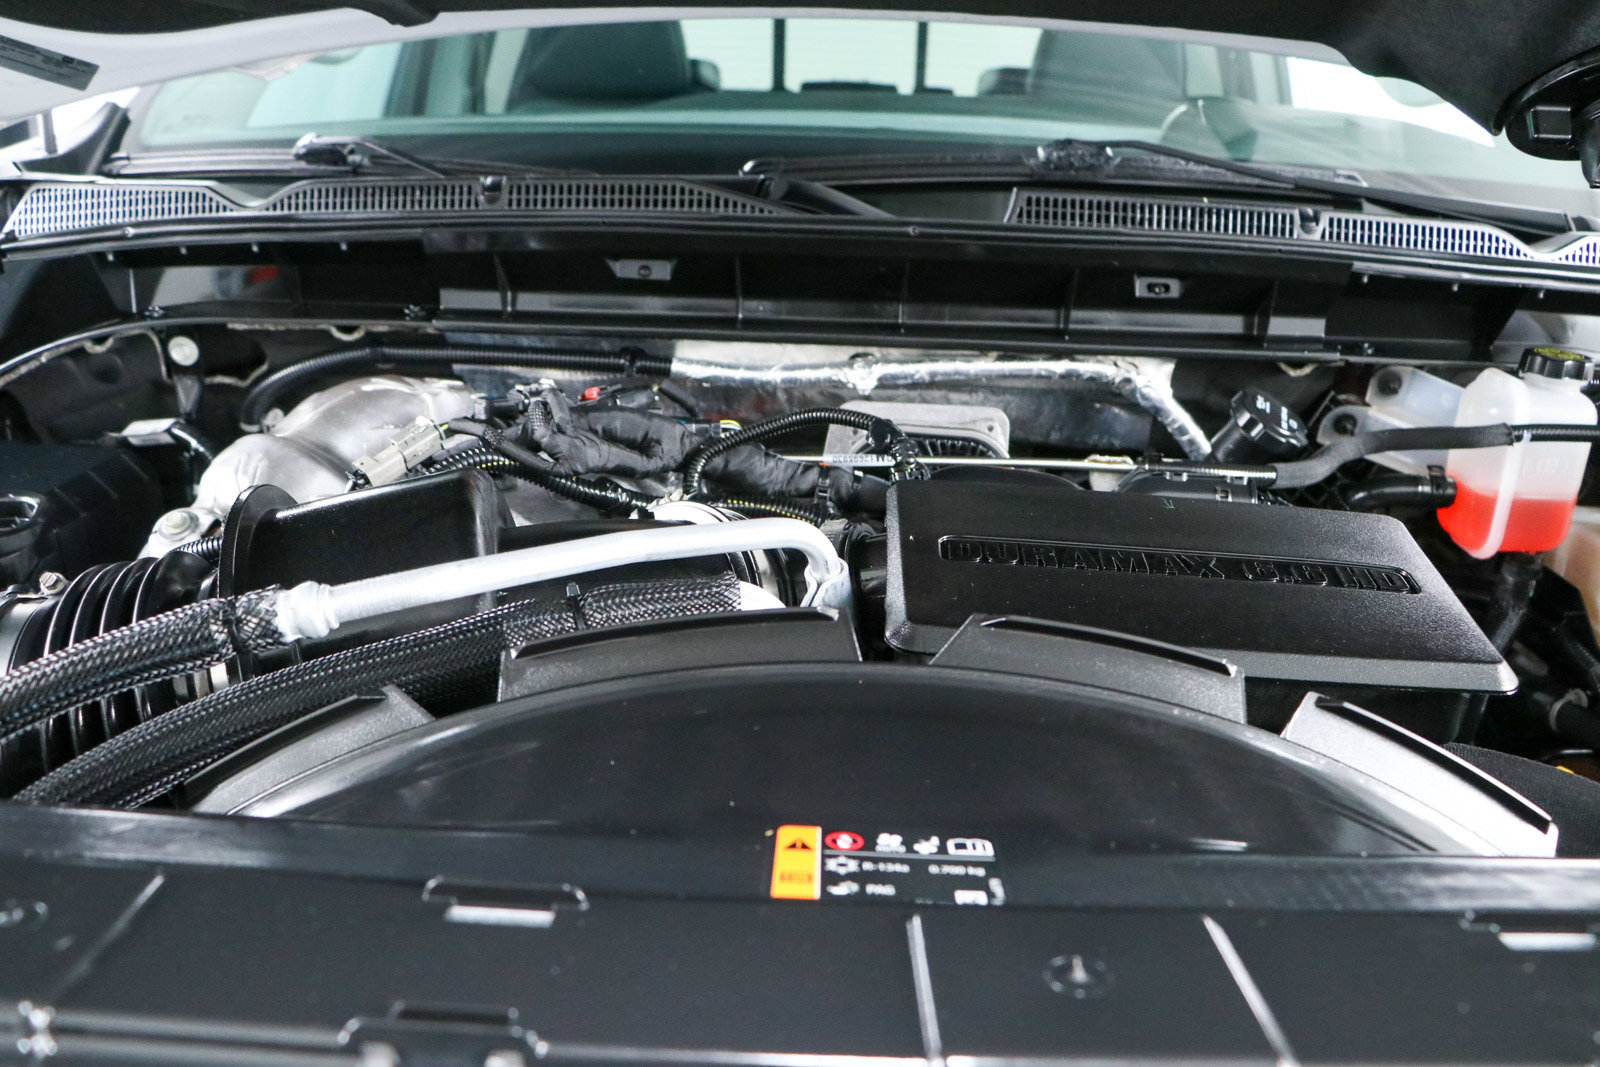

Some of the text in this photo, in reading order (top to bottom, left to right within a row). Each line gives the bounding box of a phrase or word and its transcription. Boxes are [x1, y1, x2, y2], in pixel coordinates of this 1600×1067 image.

[947, 540, 1410, 594] DURAMAX 6.6 HD
